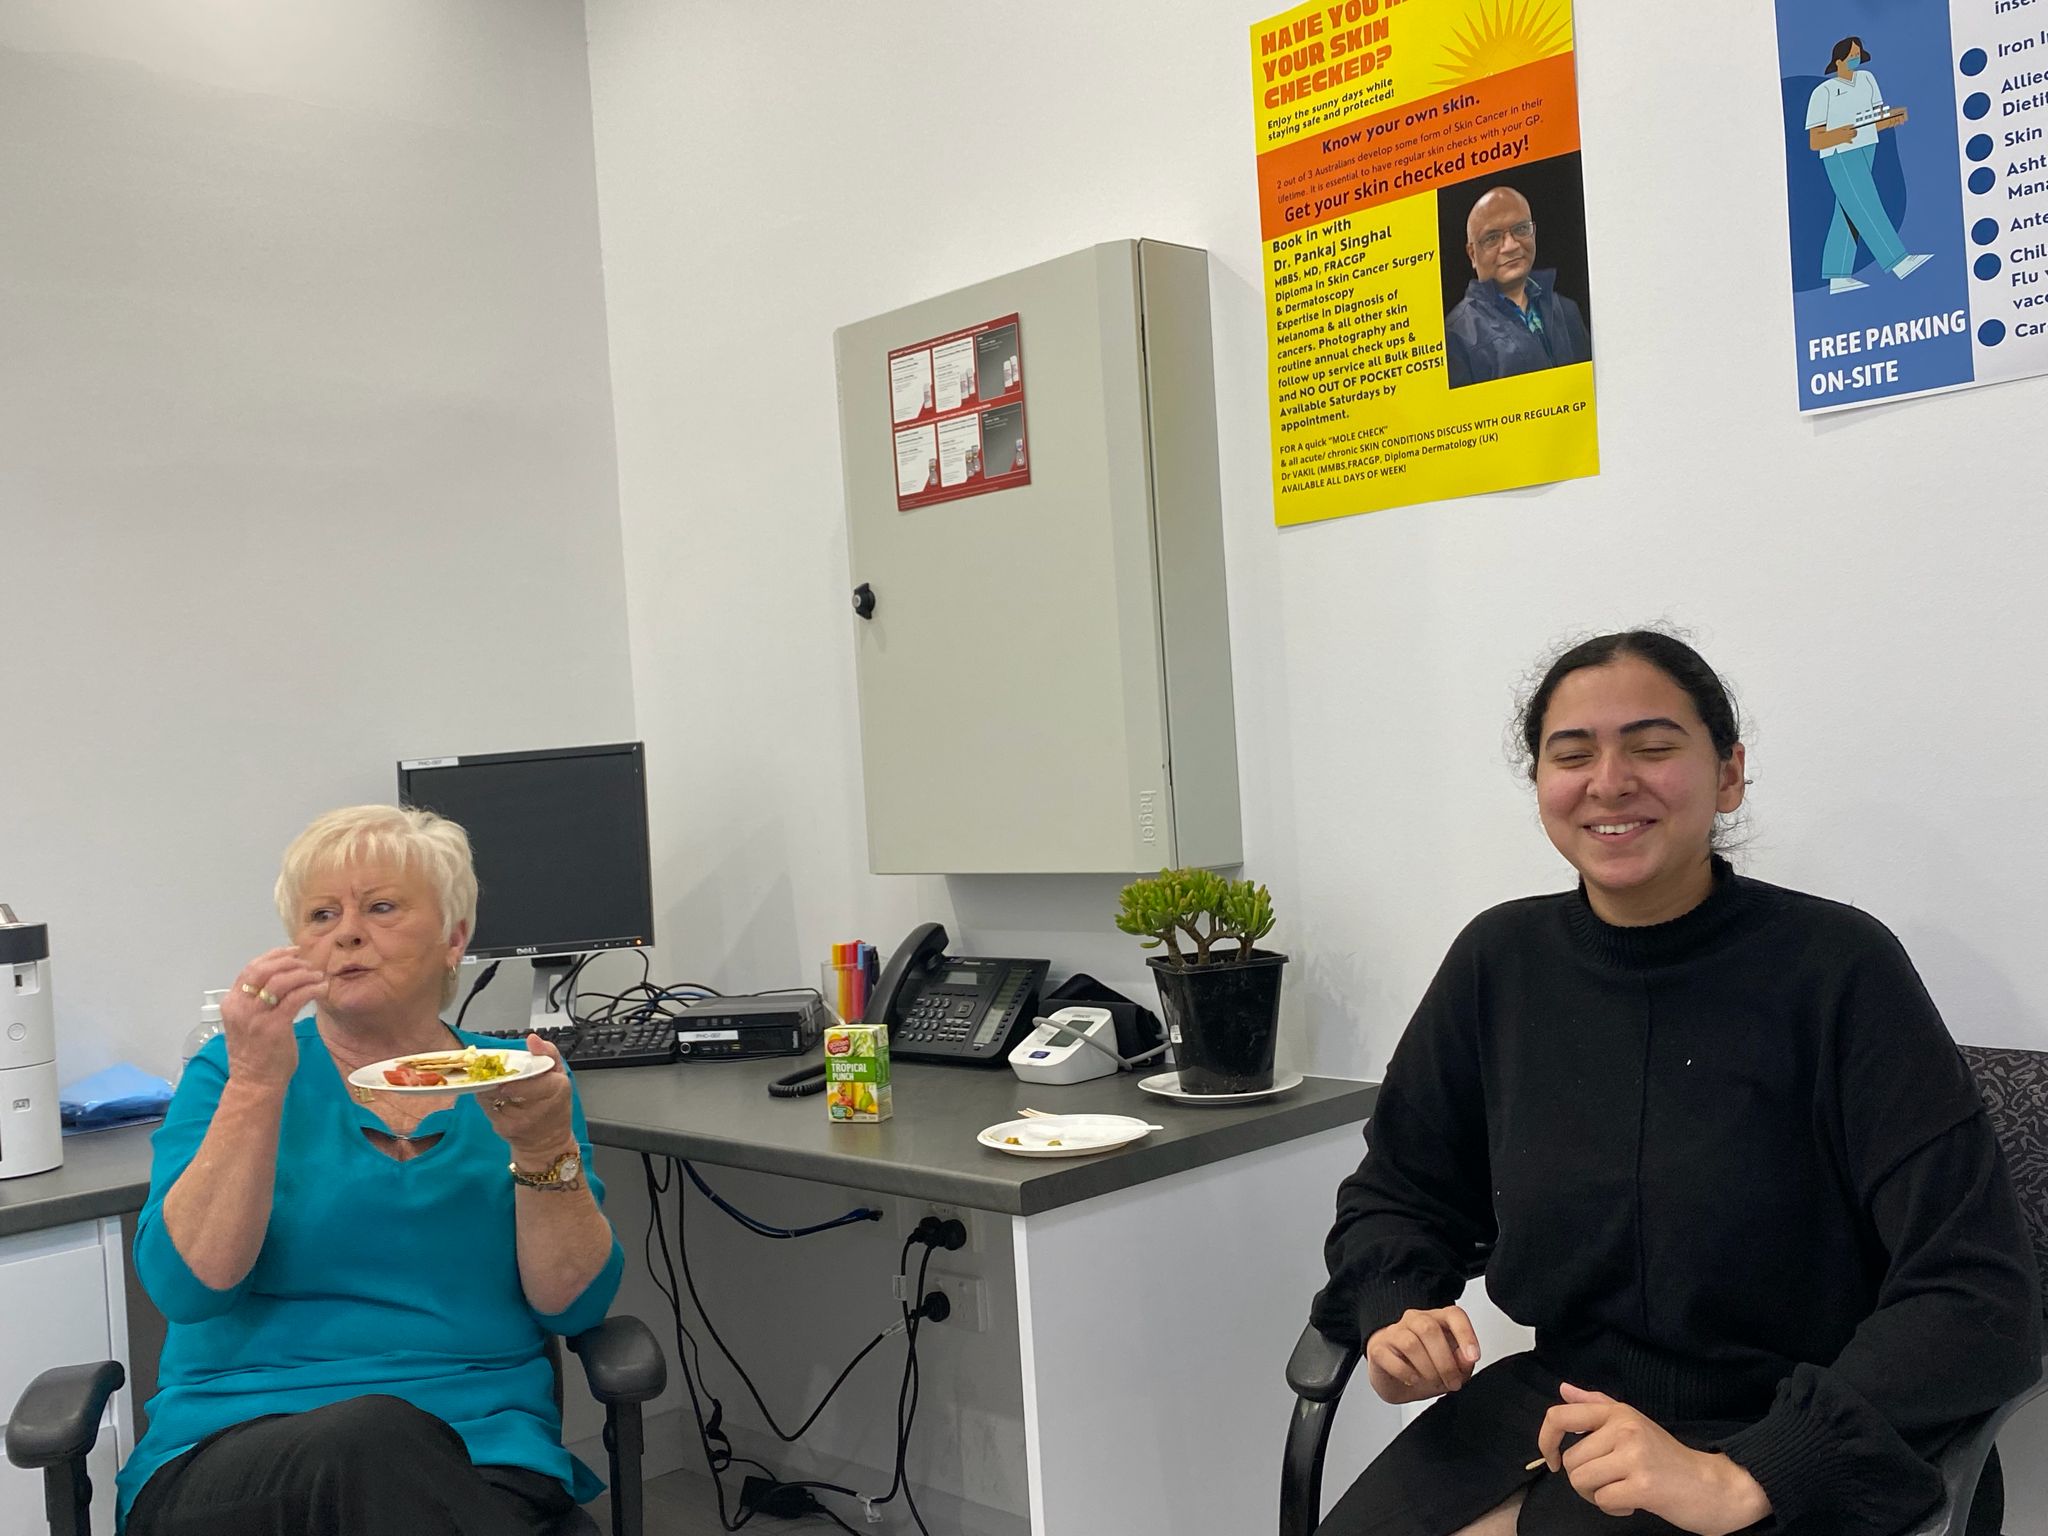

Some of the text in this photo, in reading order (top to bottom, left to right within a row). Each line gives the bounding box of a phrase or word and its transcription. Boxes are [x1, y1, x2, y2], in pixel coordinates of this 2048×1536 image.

[1261, 0, 1378, 56] HAVE YOU
[1999, 38, 2034, 57] Iron
[1263, 16, 1388, 83] YOUR SKIN
[1264, 45, 1392, 109] CHECKED?
[1268, 79, 1392, 129] Enjoy the sunny days while
[1268, 89, 1394, 141] staying safe and protected!
[1322, 95, 1480, 154] Know your own skin.
[1277, 98, 1542, 189] 2 out of 3 Australians develop some form of Skin Cancer in their
[1326, 173, 1358, 189] essential
[1361, 168, 1369, 176] to
[1372, 162, 1392, 173] have
[1394, 148, 1424, 167] regular
[1428, 146, 1444, 156] skin
[1447, 135, 1477, 151] checks
[1480, 128, 1499, 140] with
[1502, 122, 1522, 135] your
[1525, 114, 1543, 126] GP.
[2004, 128, 2042, 147] Skin
[1285, 134, 1528, 222] Get your skin checked today!
[2007, 155, 2047, 177] Asht
[1273, 219, 1351, 253] Book in with
[1274, 226, 1391, 272] Dr. Pankaj Singhal
[2010, 244, 2047, 263] Chil
[1275, 253, 1365, 288] MBBS, MD, FRACGP
[1275, 250, 1435, 302] Diploma in Skin Cancer Surgery
[2012, 272, 2038, 287] Flu
[1276, 287, 1354, 316] & Dermatoscopy
[1277, 289, 1398, 331] Expertise in Diagnosis of
[1278, 304, 1408, 345] Melanoma & all other skin
[1278, 318, 1409, 359] cancers. Photography and
[1809, 309, 1966, 360] FREE PARKING
[1278, 332, 1415, 374] routine annual check ups &
[1278, 342, 1443, 388] follow up service all Bulk Billed
[1279, 357, 1444, 403] and NO OUT OF POCKET COSTS!
[1811, 360, 1899, 395] ON-SITE
[1280, 385, 1396, 418] Available Saturdays by
[1281, 410, 1349, 433] appointment.
[1280, 444, 1295, 454] FOR
[1305, 438, 1326, 450] quick
[1289, 457, 1298, 466] all
[1300, 452, 1325, 463] acute/
[1328, 447, 1357, 459] chronic
[1360, 441, 1379, 453] SKIN
[1382, 431, 1435, 451] CONDITIONS
[1437, 424, 1472, 438] DISCUSS
[1475, 418, 1498, 430] WITH
[1501, 414, 1521, 425] OUR
[1525, 405, 1569, 420] REGULAR
[1573, 402, 1586, 413] GP
[1293, 468, 1315, 479] VAKIL
[1385, 449, 1419, 463] Diploma
[1422, 437, 1477, 456] Dermatology
[1480, 432, 1498, 446] (UK)
[1282, 479, 1324, 494] AVAILABLE
[1327, 477, 1341, 486] ALL
[1344, 472, 1365, 483] DAYS
[1367, 470, 1378, 479] OF
[1139, 790, 1157, 846] hager
[516, 947, 538, 955] DELL
[831, 1064, 867, 1072] TROPICAL
